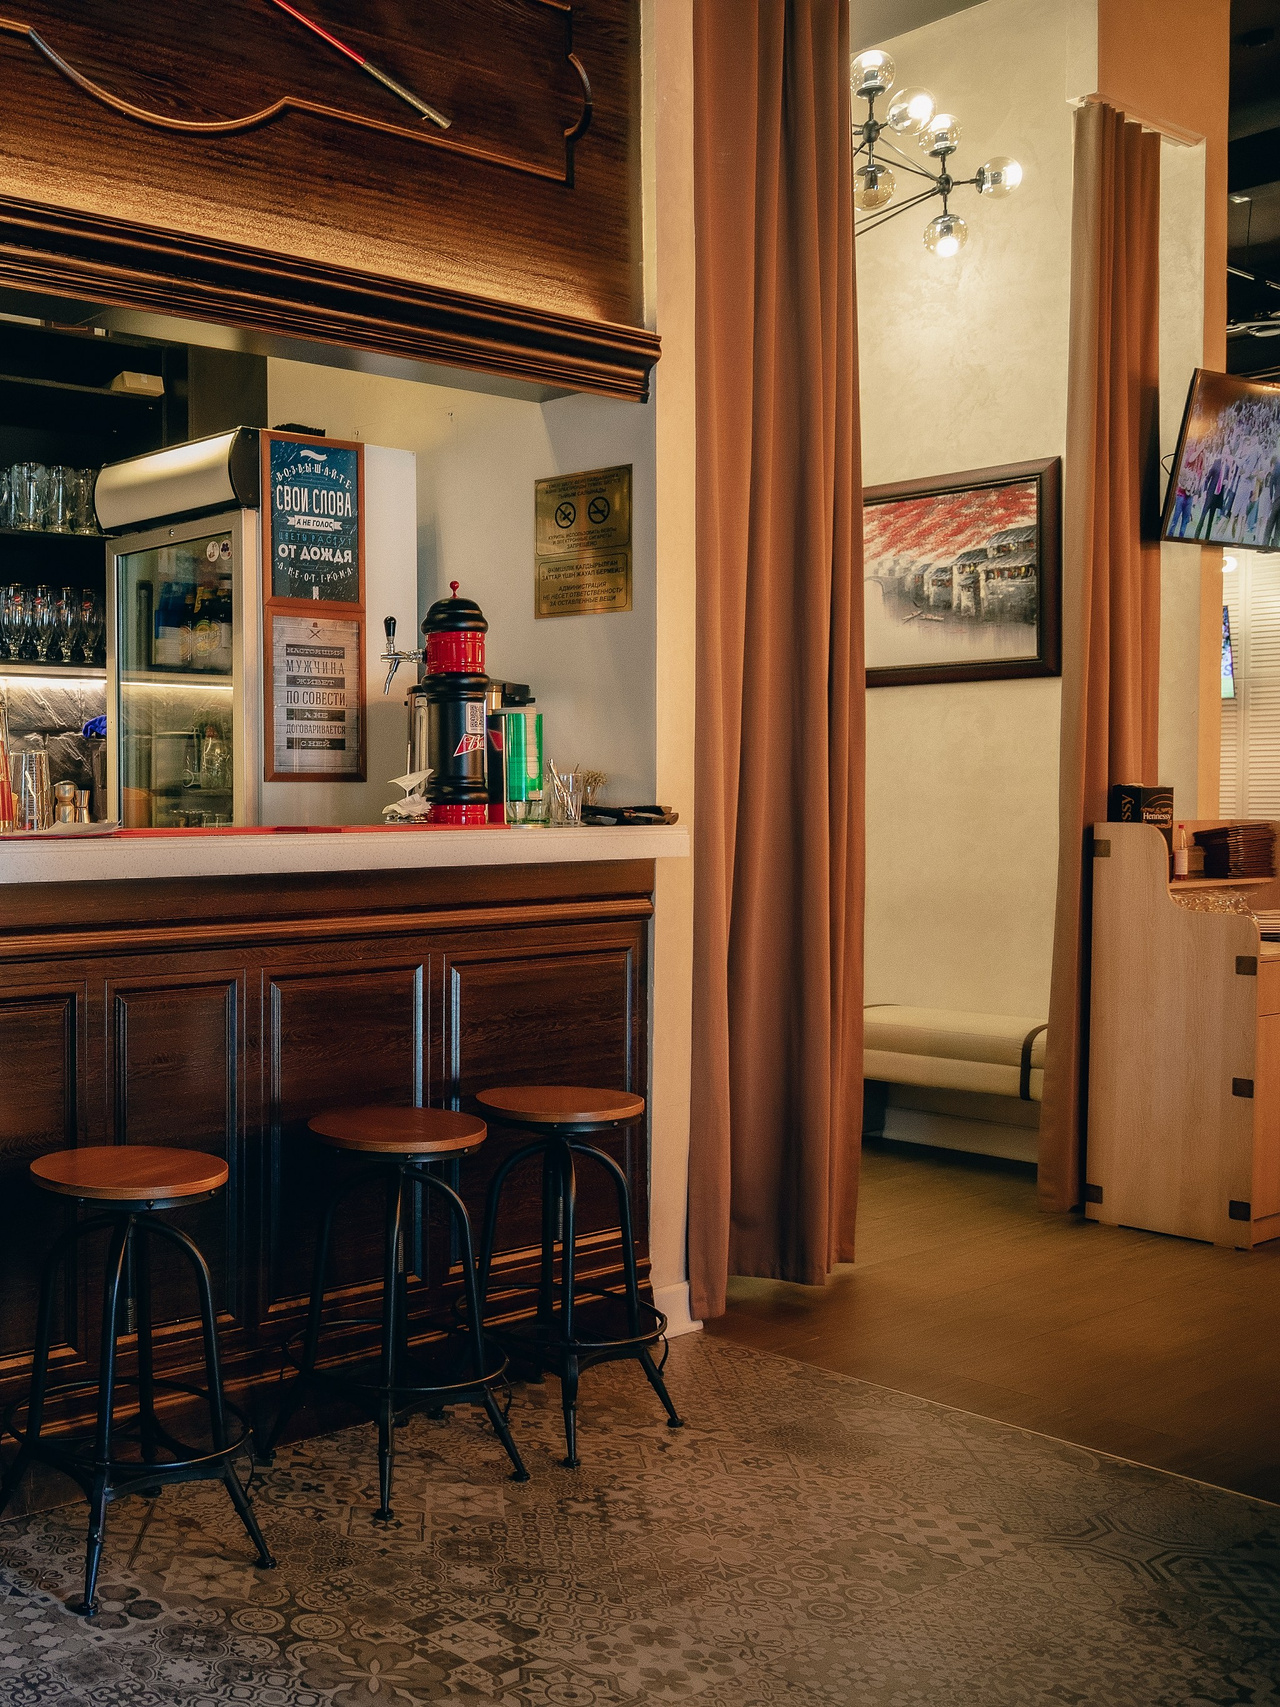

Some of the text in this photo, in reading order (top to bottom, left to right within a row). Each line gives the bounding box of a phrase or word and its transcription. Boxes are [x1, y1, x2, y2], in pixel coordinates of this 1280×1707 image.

[276, 485, 352, 517] СВОИ СЛОВА
[312, 520, 334, 530] ГОЛОС
[279, 532, 307, 541] ЦВЕТЫ
[278, 544, 352, 563] ОТ ДОЖДЯ
[559, 581, 607, 591] АДМИНИСТРАЦИЯ
[570, 587, 624, 598] ОТВЕТСТВЕННОСТИ
[558, 597, 598, 606] ОСТАВЛЕННЫЕ
[286, 660, 345, 675] МУЖЧИНА
[286, 690, 348, 707] ПО СОВЕСТИ,
[286, 724, 346, 735] ДОГОВАРИВАЕТСЯ
[1143, 812, 1171, 820] Hennessy
